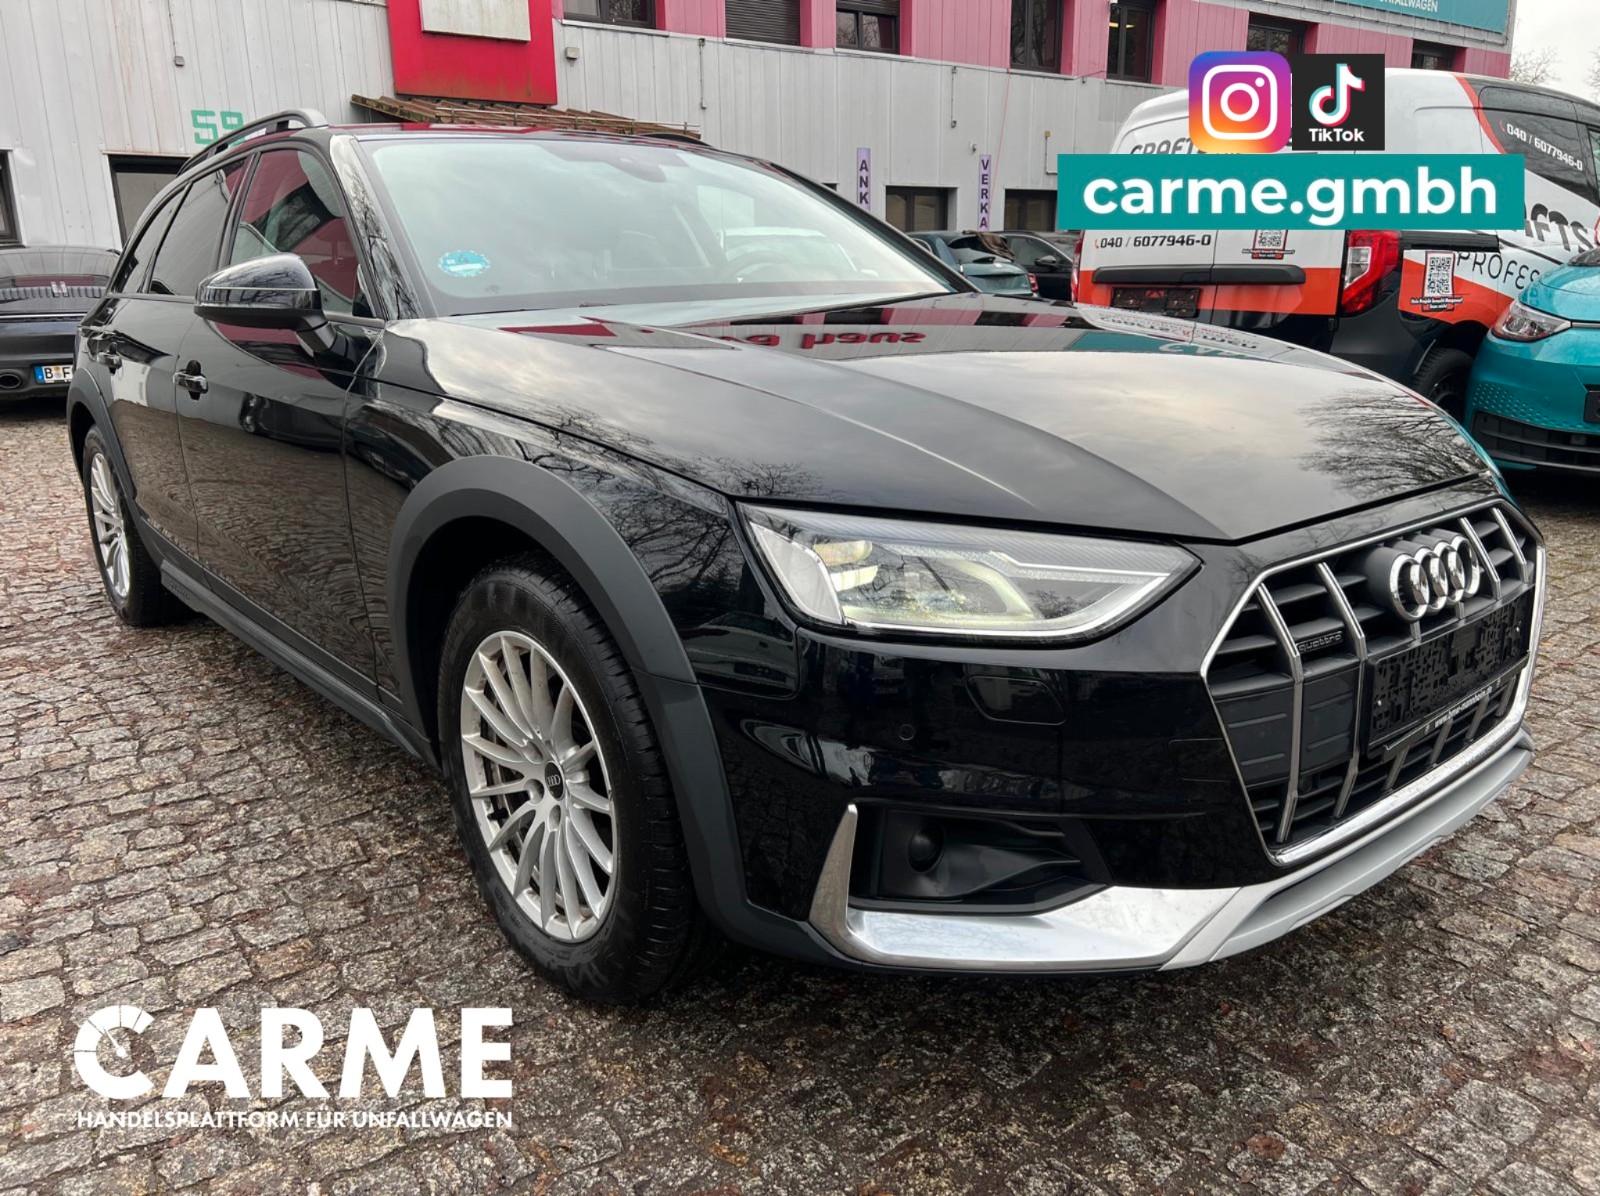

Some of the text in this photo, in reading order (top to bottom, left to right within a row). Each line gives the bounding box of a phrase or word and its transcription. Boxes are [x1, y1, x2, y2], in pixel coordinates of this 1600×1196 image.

[1380, 0, 1439, 12] ALLWAGEN
[1506, 123, 1527, 142] 040
[1534, 137, 1583, 171] 6077946-0
[859, 159, 869, 204] ANK
[979, 159, 989, 228] VERKA
[1100, 236, 1122, 248] 040
[1133, 234, 1211, 247] 6077946-0
[44, 367, 53, 379] B
[1298, 634, 1341, 653] quattro
